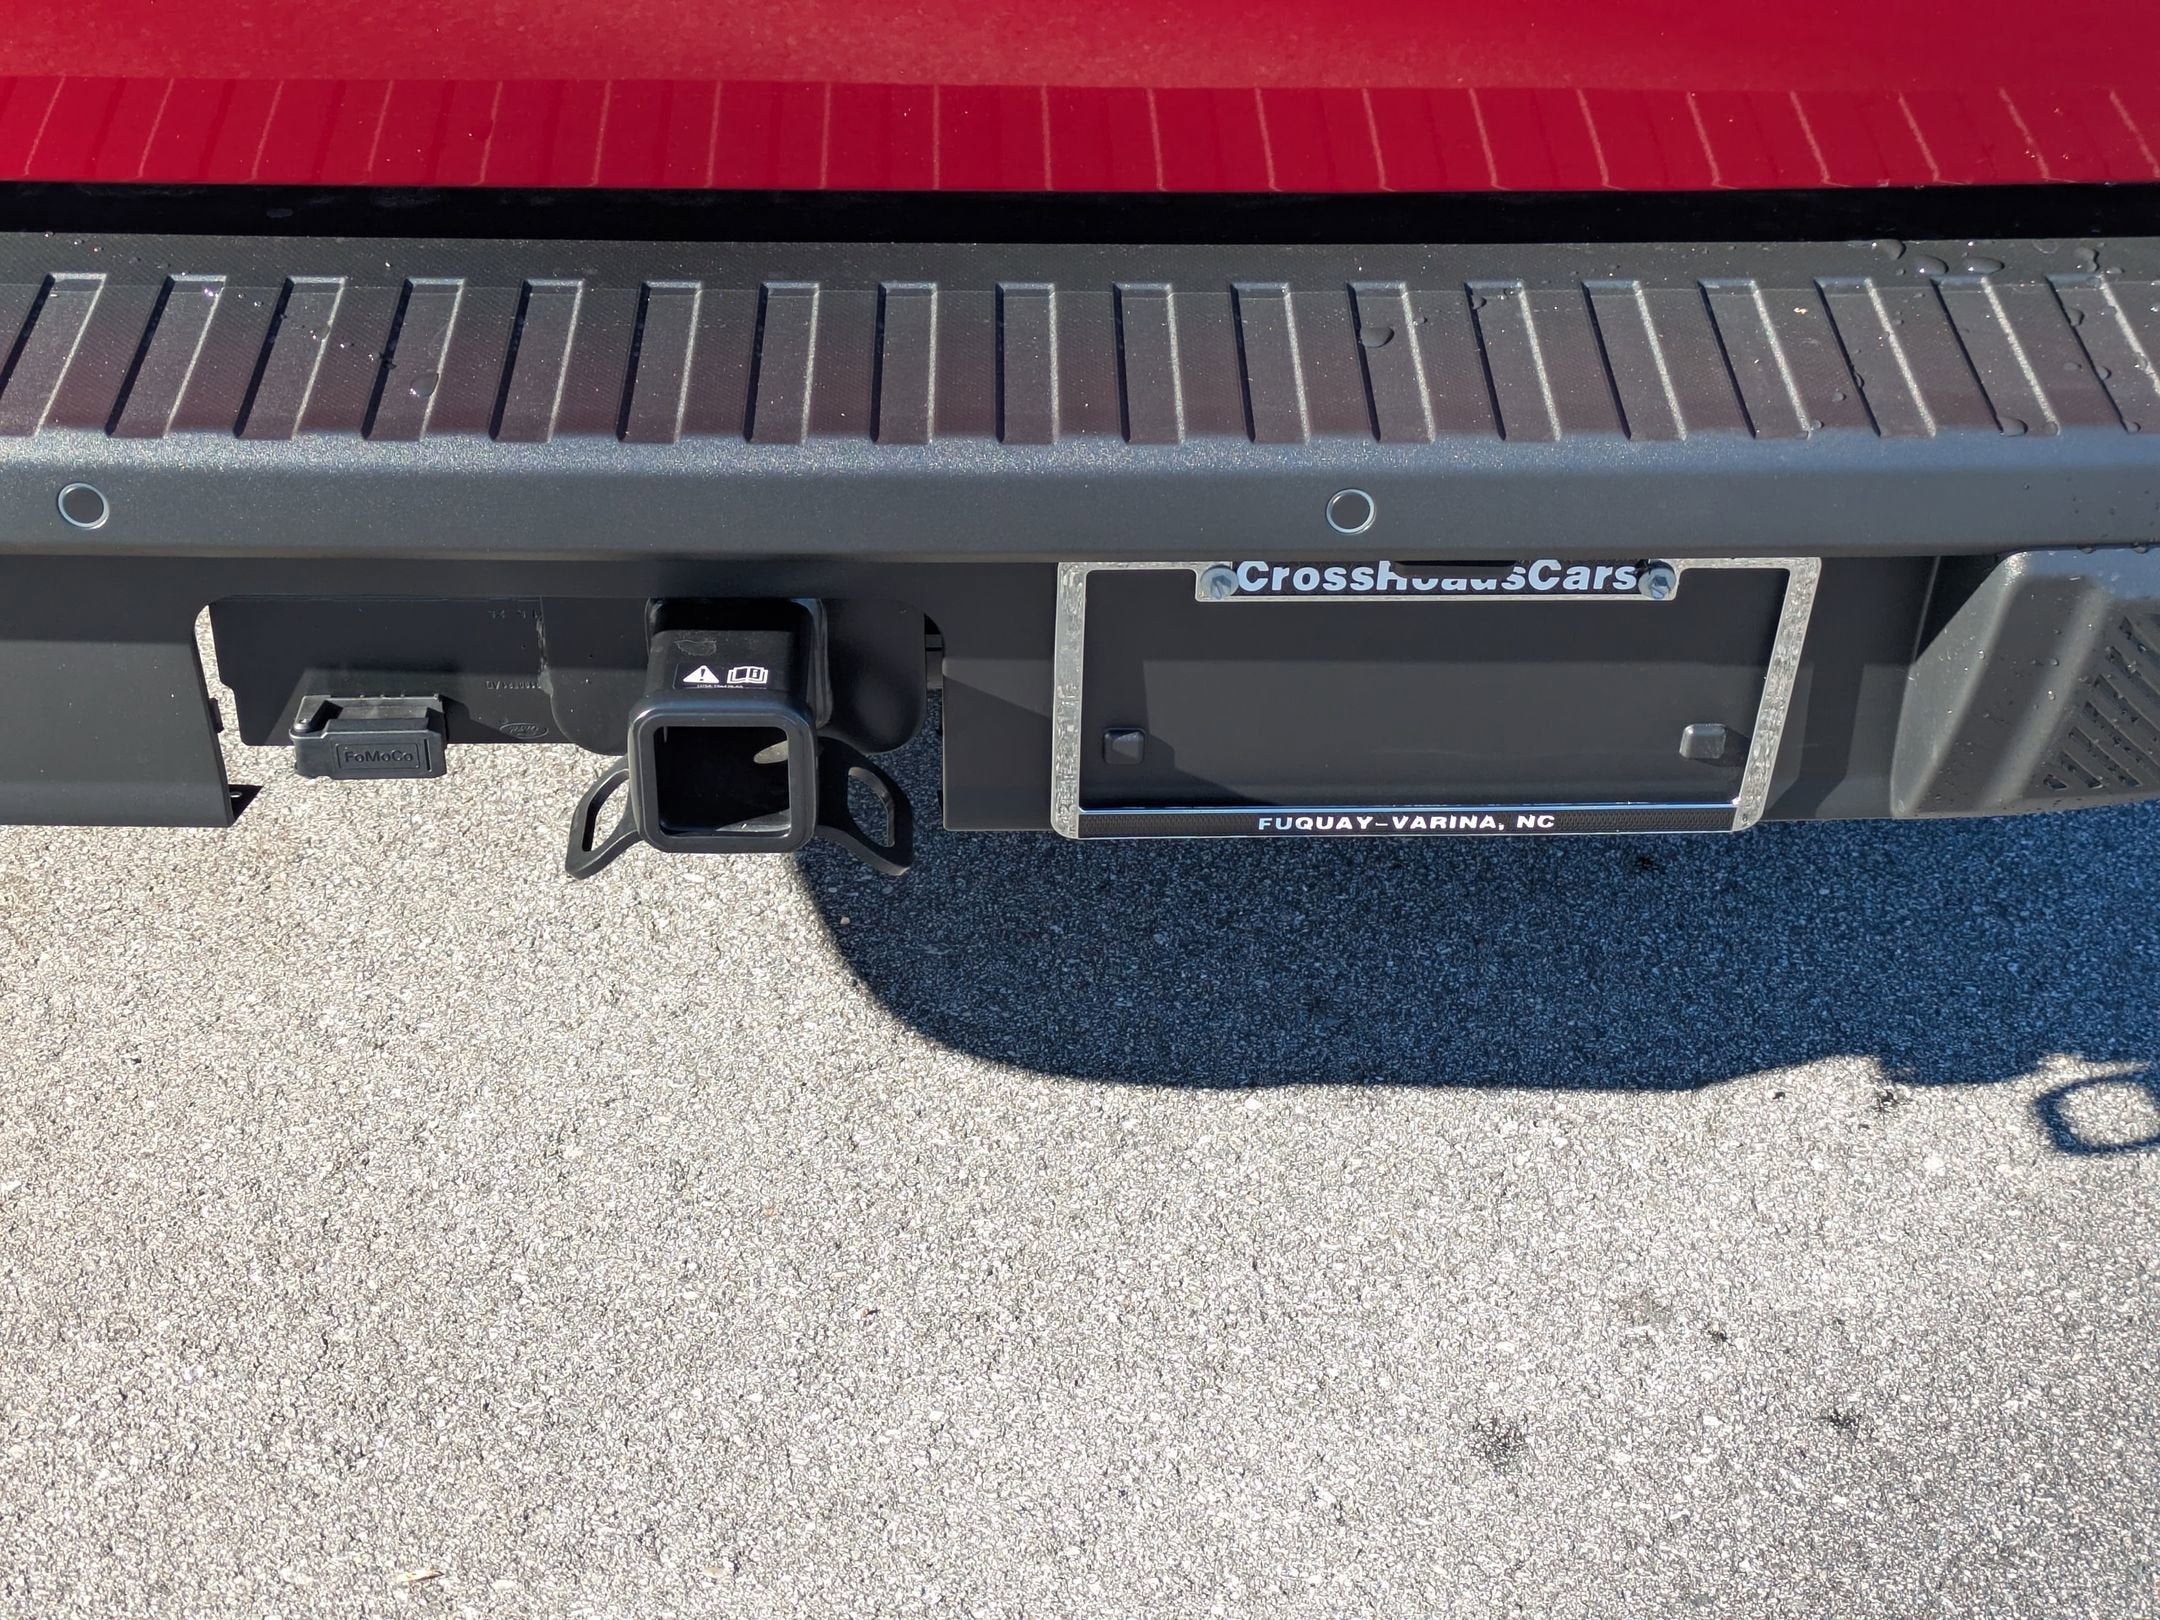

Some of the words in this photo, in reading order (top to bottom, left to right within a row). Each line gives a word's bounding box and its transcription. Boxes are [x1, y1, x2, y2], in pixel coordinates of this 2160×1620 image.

[344, 750, 414, 763] FoMoCo
[1257, 815, 1505, 831] FUQUAY-VARINA,
[1516, 814, 1556, 829] NC
